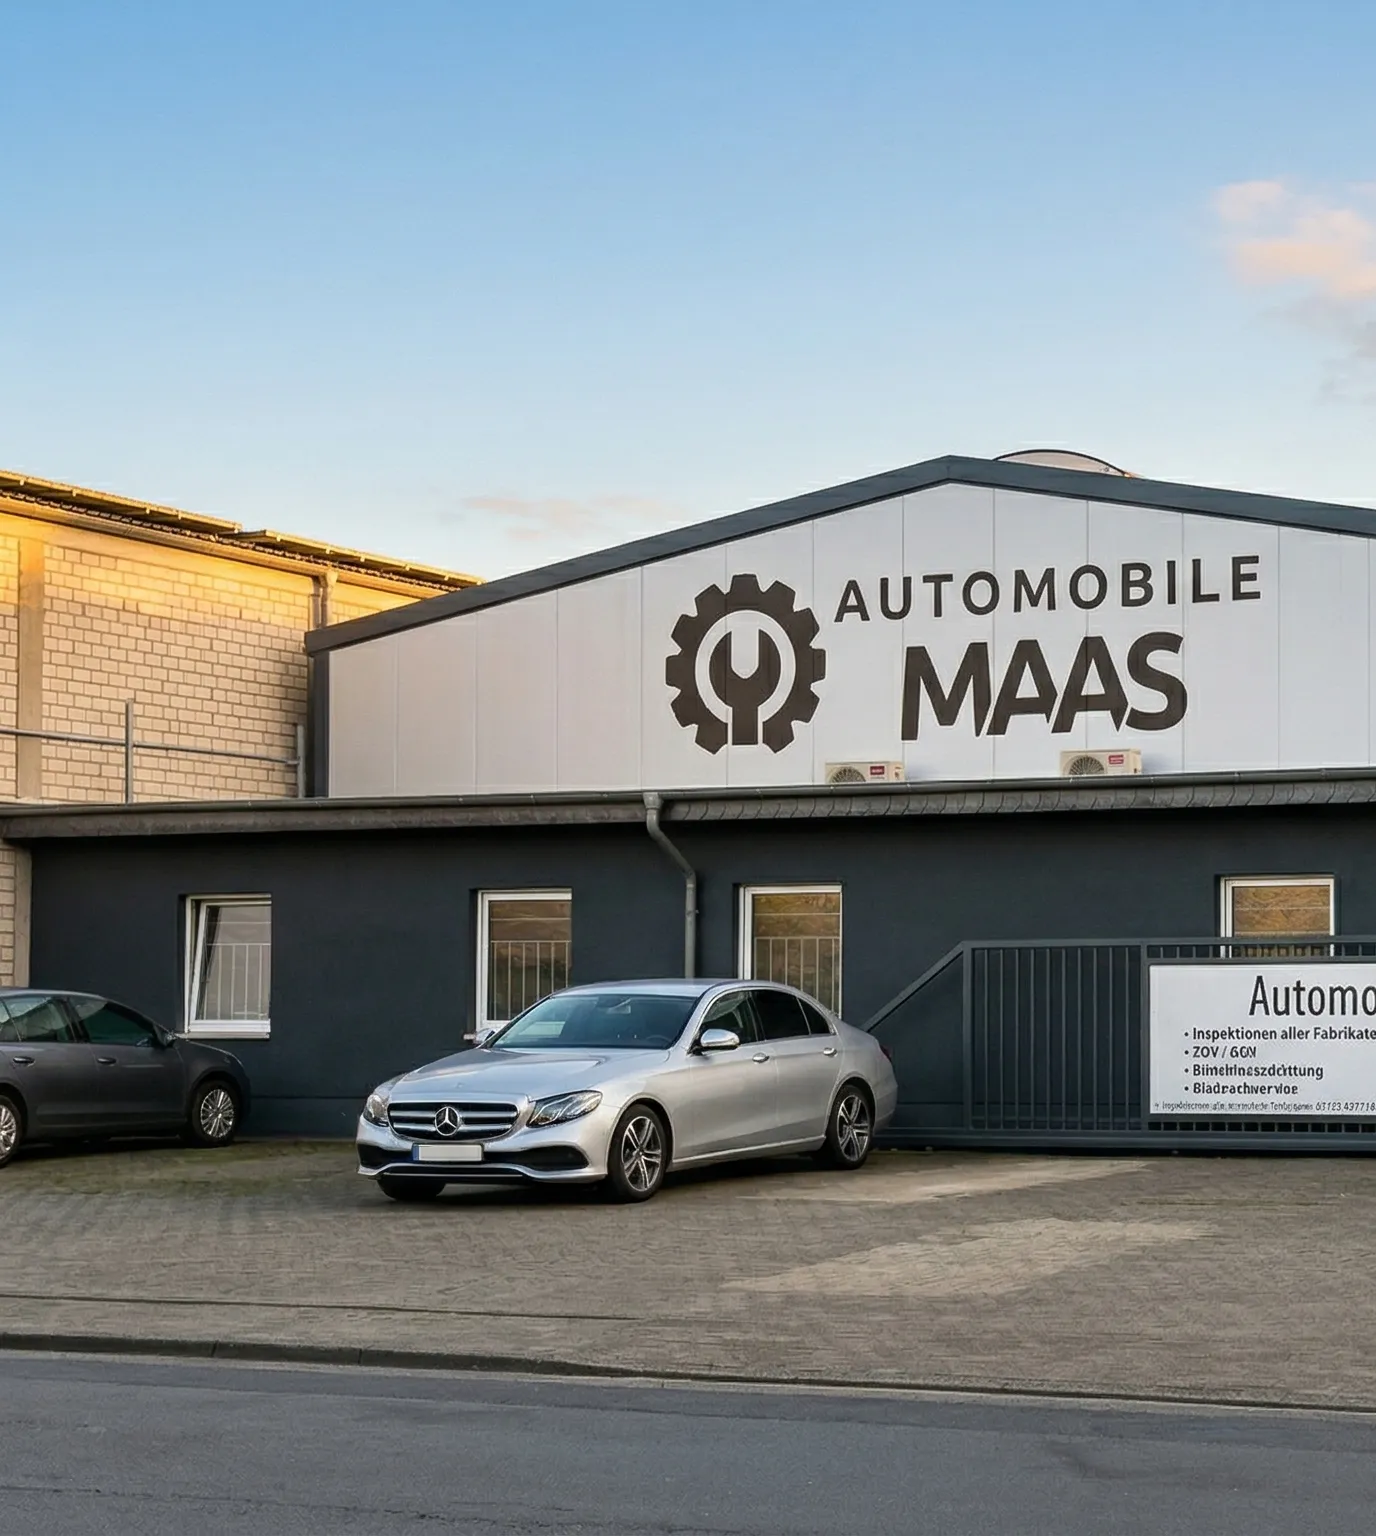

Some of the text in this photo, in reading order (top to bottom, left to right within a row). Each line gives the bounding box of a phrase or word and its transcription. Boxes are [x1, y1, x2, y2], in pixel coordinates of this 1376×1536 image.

[834, 555, 1261, 623] AUTOMOBILE
[901, 631, 1188, 741] MAAS
[1193, 1027, 1277, 1042] Inspektionen
[1281, 1027, 1310, 1040] aller
[1193, 1046, 1219, 1058] ZOV
